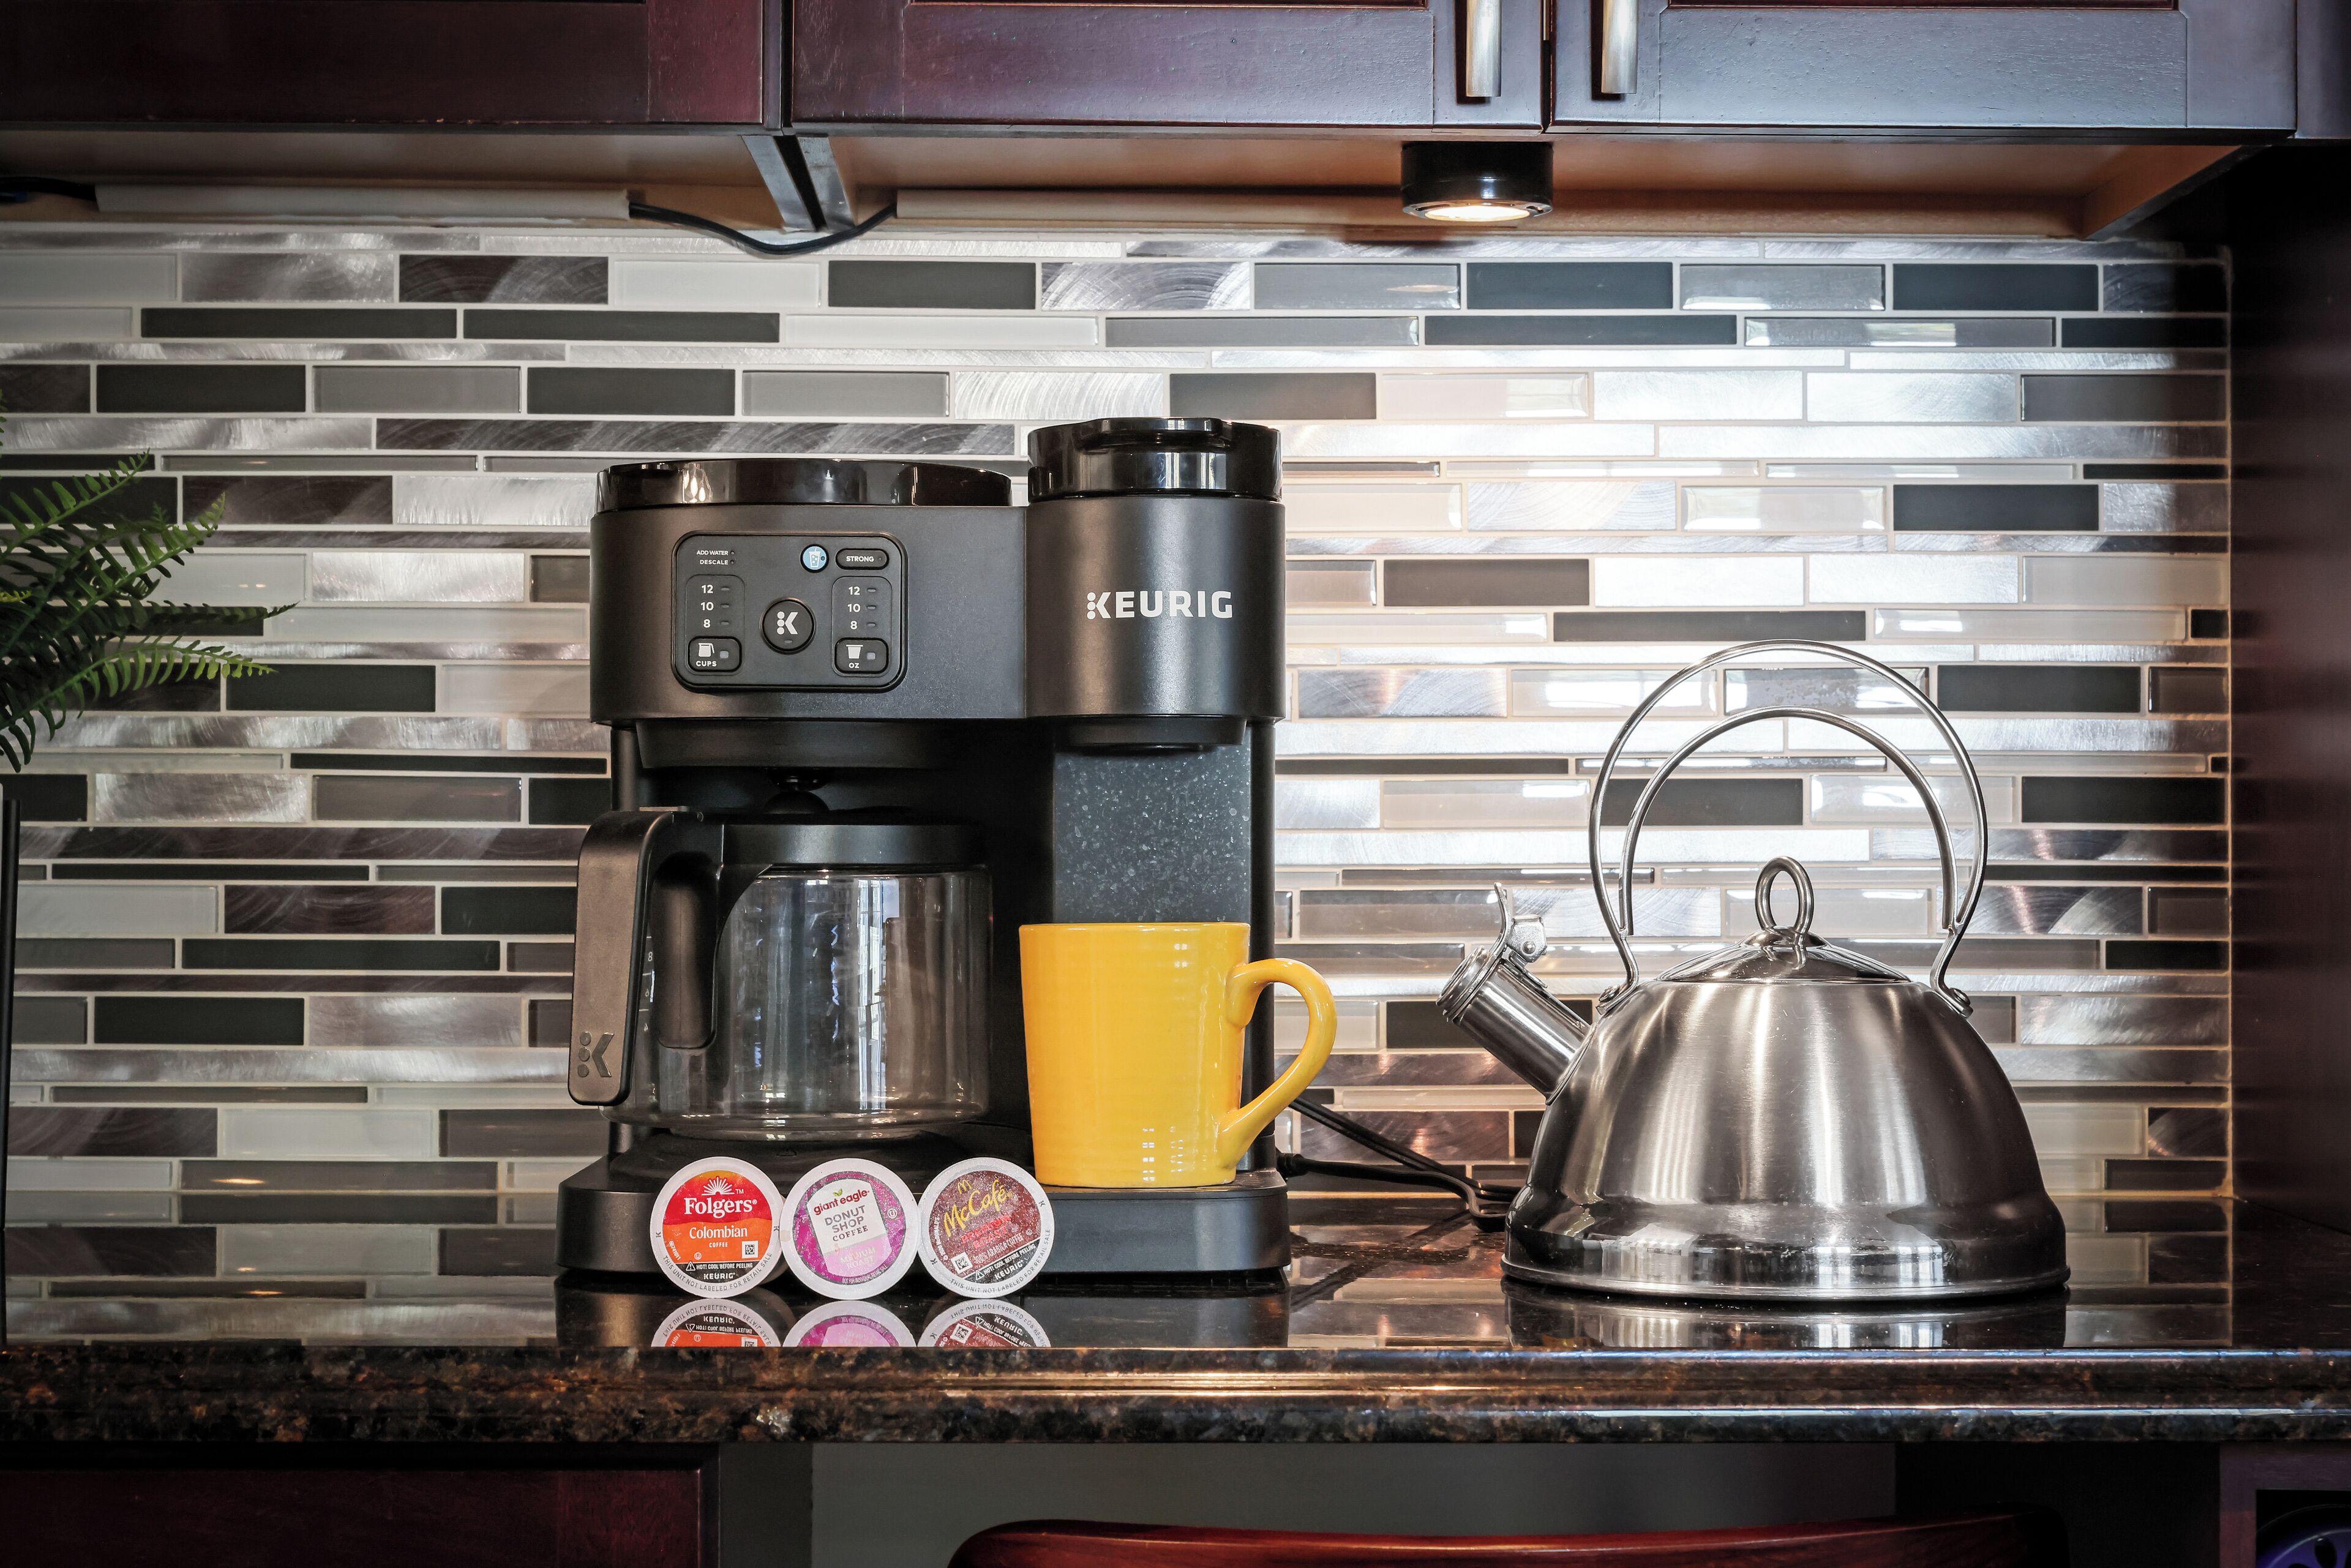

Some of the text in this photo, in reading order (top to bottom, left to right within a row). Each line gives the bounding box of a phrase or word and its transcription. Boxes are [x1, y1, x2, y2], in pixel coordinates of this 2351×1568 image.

[701, 585, 713, 594] 12
[848, 587, 860, 596] 12
[700, 602, 714, 611] 10
[847, 604, 861, 613] 10
[1087, 590, 1232, 620] KEURIG
[703, 619, 711, 628] 8
[850, 621, 858, 630] 8
[814, 1190, 868, 1215] giant eagle
[943, 1179, 1008, 1237] McCafé
[825, 1205, 866, 1226] DONUT
[831, 1215, 864, 1234] SHOP
[689, 1225, 748, 1239] Colombian
[833, 1225, 869, 1242] COFFEE
[972, 1225, 1008, 1250] ROAST
[1007, 1233, 1024, 1247] COFFEE
[994, 1261, 1005, 1269] COOL
[1005, 1253, 1019, 1264] BEFORE
[1019, 1244, 1037, 1256] PEELING
[663, 1255, 673, 1269] THIS
[673, 1269, 686, 1281] UNIT
[686, 1279, 698, 1288] NOT
[730, 1281, 741, 1289] FOR
[743, 1268, 762, 1284] RETAIL
[761, 1253, 772, 1267] SALE
[951, 1278, 964, 1289] THIS
[997, 1277, 1024, 1292] LABELED
[1024, 1266, 1036, 1278] FOR
[1034, 1247, 1047, 1267] RETAIL
[994, 1261, 1022, 1280] KEURIG
